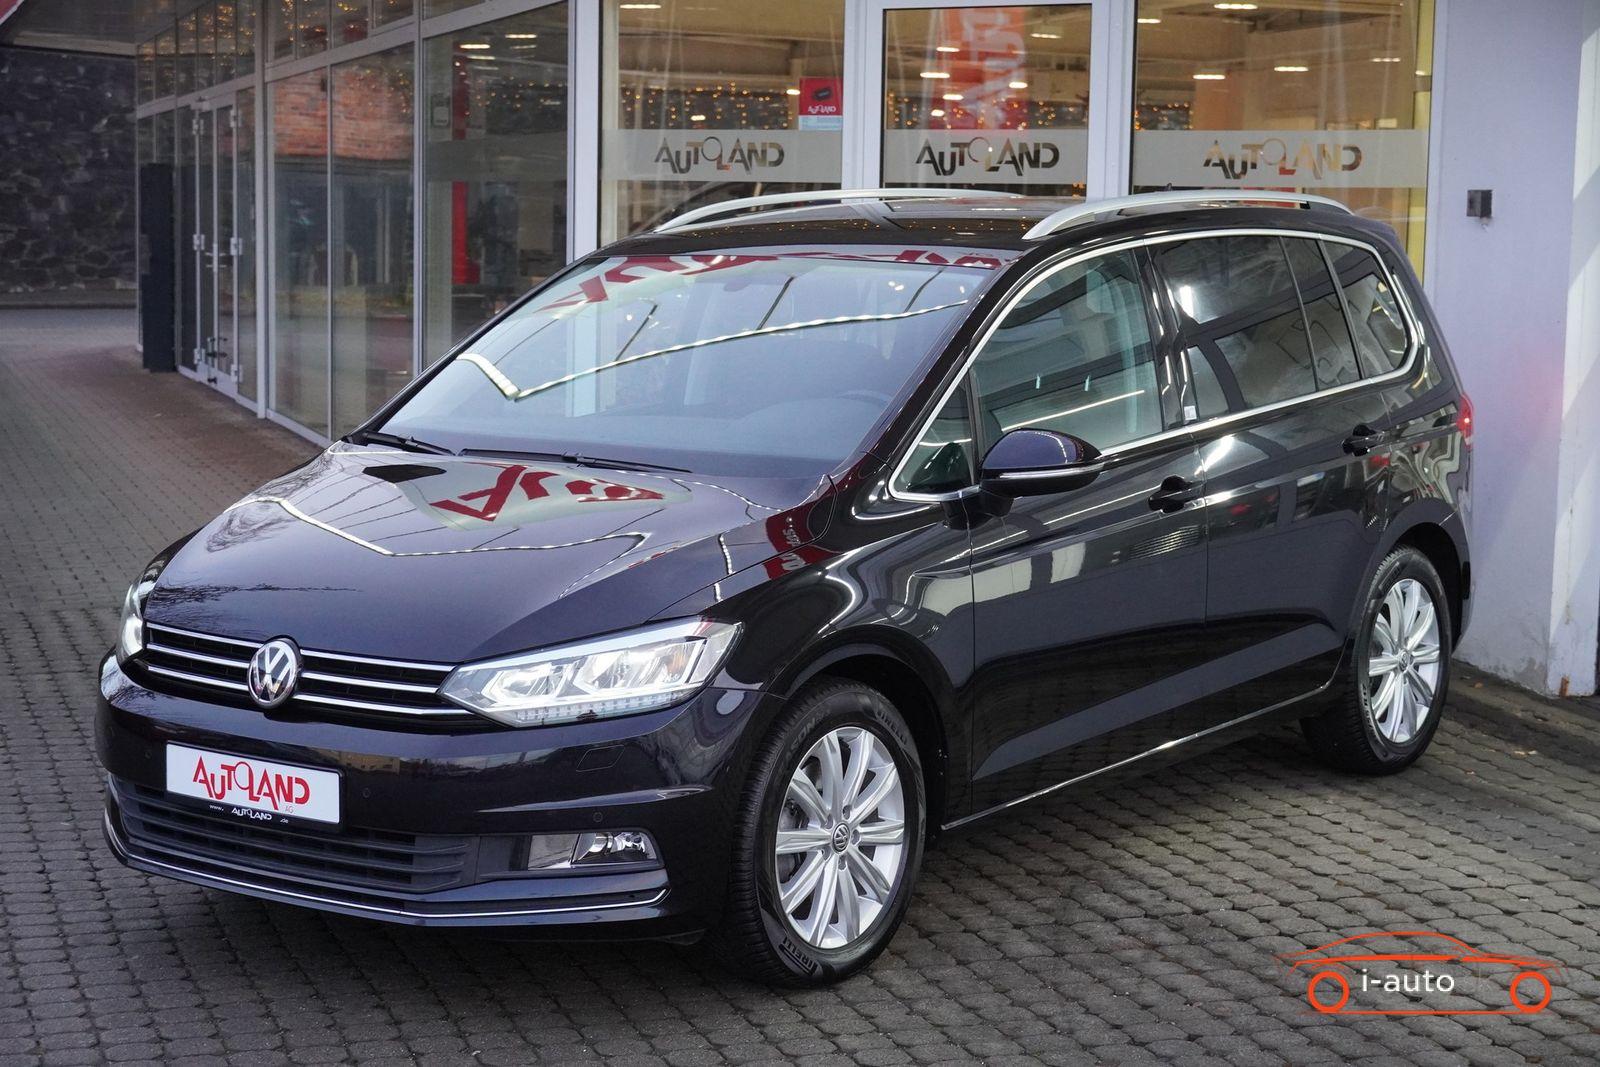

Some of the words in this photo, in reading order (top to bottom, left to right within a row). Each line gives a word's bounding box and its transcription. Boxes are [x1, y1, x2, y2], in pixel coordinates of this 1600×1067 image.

[653, 136, 785, 175] AUTOLAND
[915, 136, 1060, 177] AUTOLAND
[1203, 138, 1363, 180] AUTOLAND
[192, 755, 311, 811] AUTOLAND
[231, 807, 273, 821] AUTOLAND
